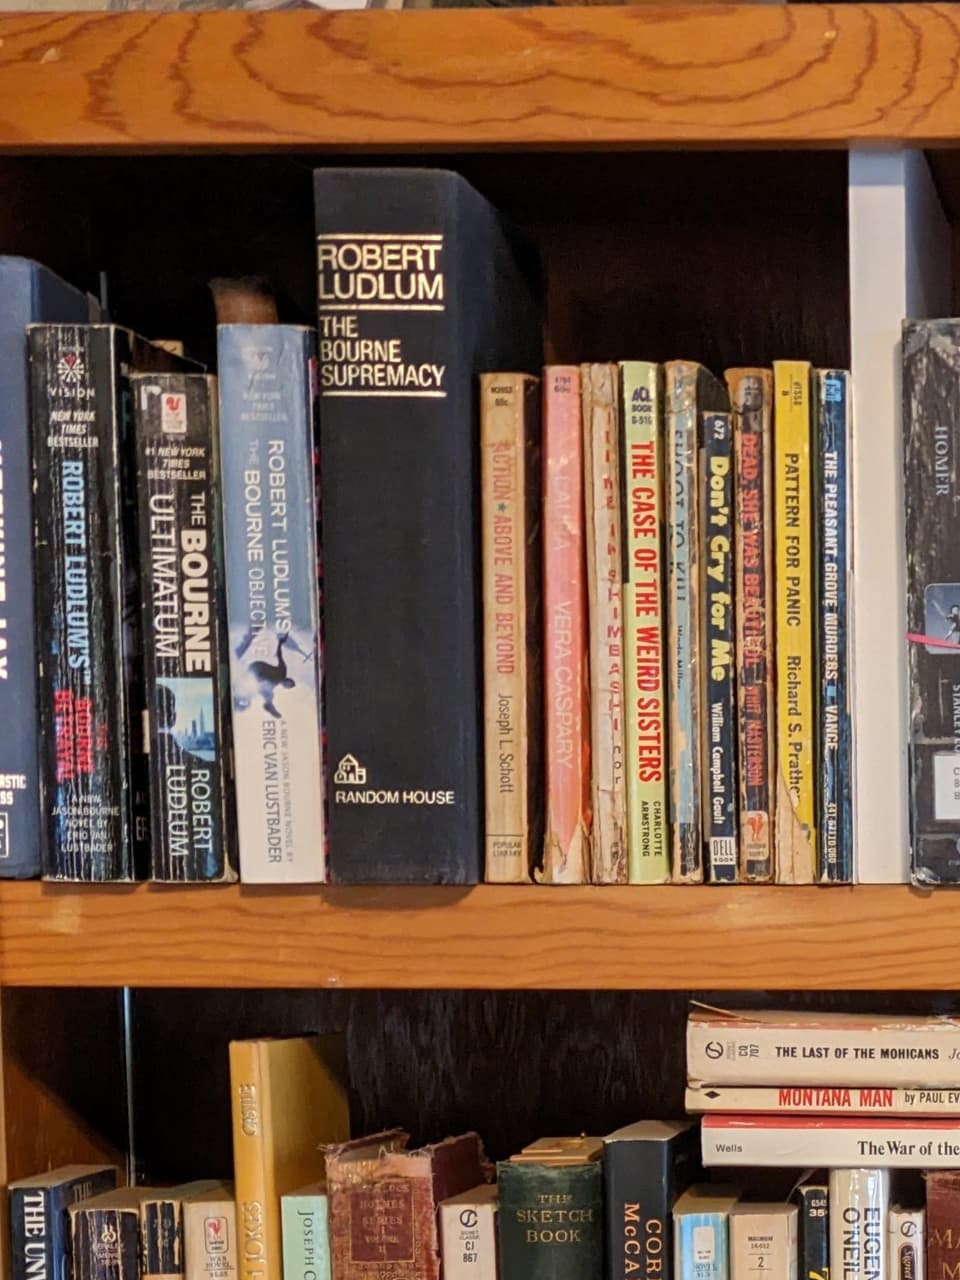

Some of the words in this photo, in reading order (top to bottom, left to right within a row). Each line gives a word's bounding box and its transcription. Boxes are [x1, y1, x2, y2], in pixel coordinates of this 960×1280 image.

[318, 243, 443, 271] ROBERT
[318, 273, 444, 300] LUDLUM
[321, 316, 359, 337] THE
[321, 340, 401, 363] BOURNE
[322, 365, 446, 388] SUPREMACY
[631, 439, 655, 478] THE
[190, 493, 205, 526] THE
[710, 457, 730, 526] Don't
[784, 453, 801, 529] PATTERN
[632, 487, 656, 538] CASE
[633, 547, 656, 576] OF
[706, 536, 730, 583] Cry
[785, 535, 801, 569] FOR
[150, 494, 175, 658] ULTIMATUM
[181, 529, 212, 673] BOURNE
[635, 577, 656, 617] THE
[710, 591, 729, 630] for
[785, 577, 802, 627] PANIC
[636, 624, 658, 691] WEIRD
[710, 641, 728, 682] Me
[637, 697, 661, 783] SISTERS
[167, 766, 189, 857] LUDLUM
[191, 770, 214, 851] ROBERT
[335, 791, 398, 803] RANDOM
[402, 791, 455, 803] HOUSE
[642, 801, 650, 857] ARMSTRONG
[653, 801, 662, 857] CHARLOTTE
[775, 1047, 797, 1057] THE
[802, 1047, 829, 1058] LAST
[835, 1047, 850, 1058] OF
[854, 1048, 875, 1058] THE
[880, 1049, 939, 1059] MOHICANS
[778, 1089, 851, 1106] MONTANA
[860, 1090, 893, 1107] MAN
[904, 1092, 915, 1105] by
[920, 1093, 944, 1103] PAUL
[715, 1144, 743, 1153] Wells
[858, 1141, 885, 1155] The
[886, 1141, 915, 1156] War
[919, 1141, 933, 1155] of
[938, 1141, 960, 1156] the
[516, 1209, 593, 1223] SKETCH
[526, 1230, 580, 1242] BOOK
